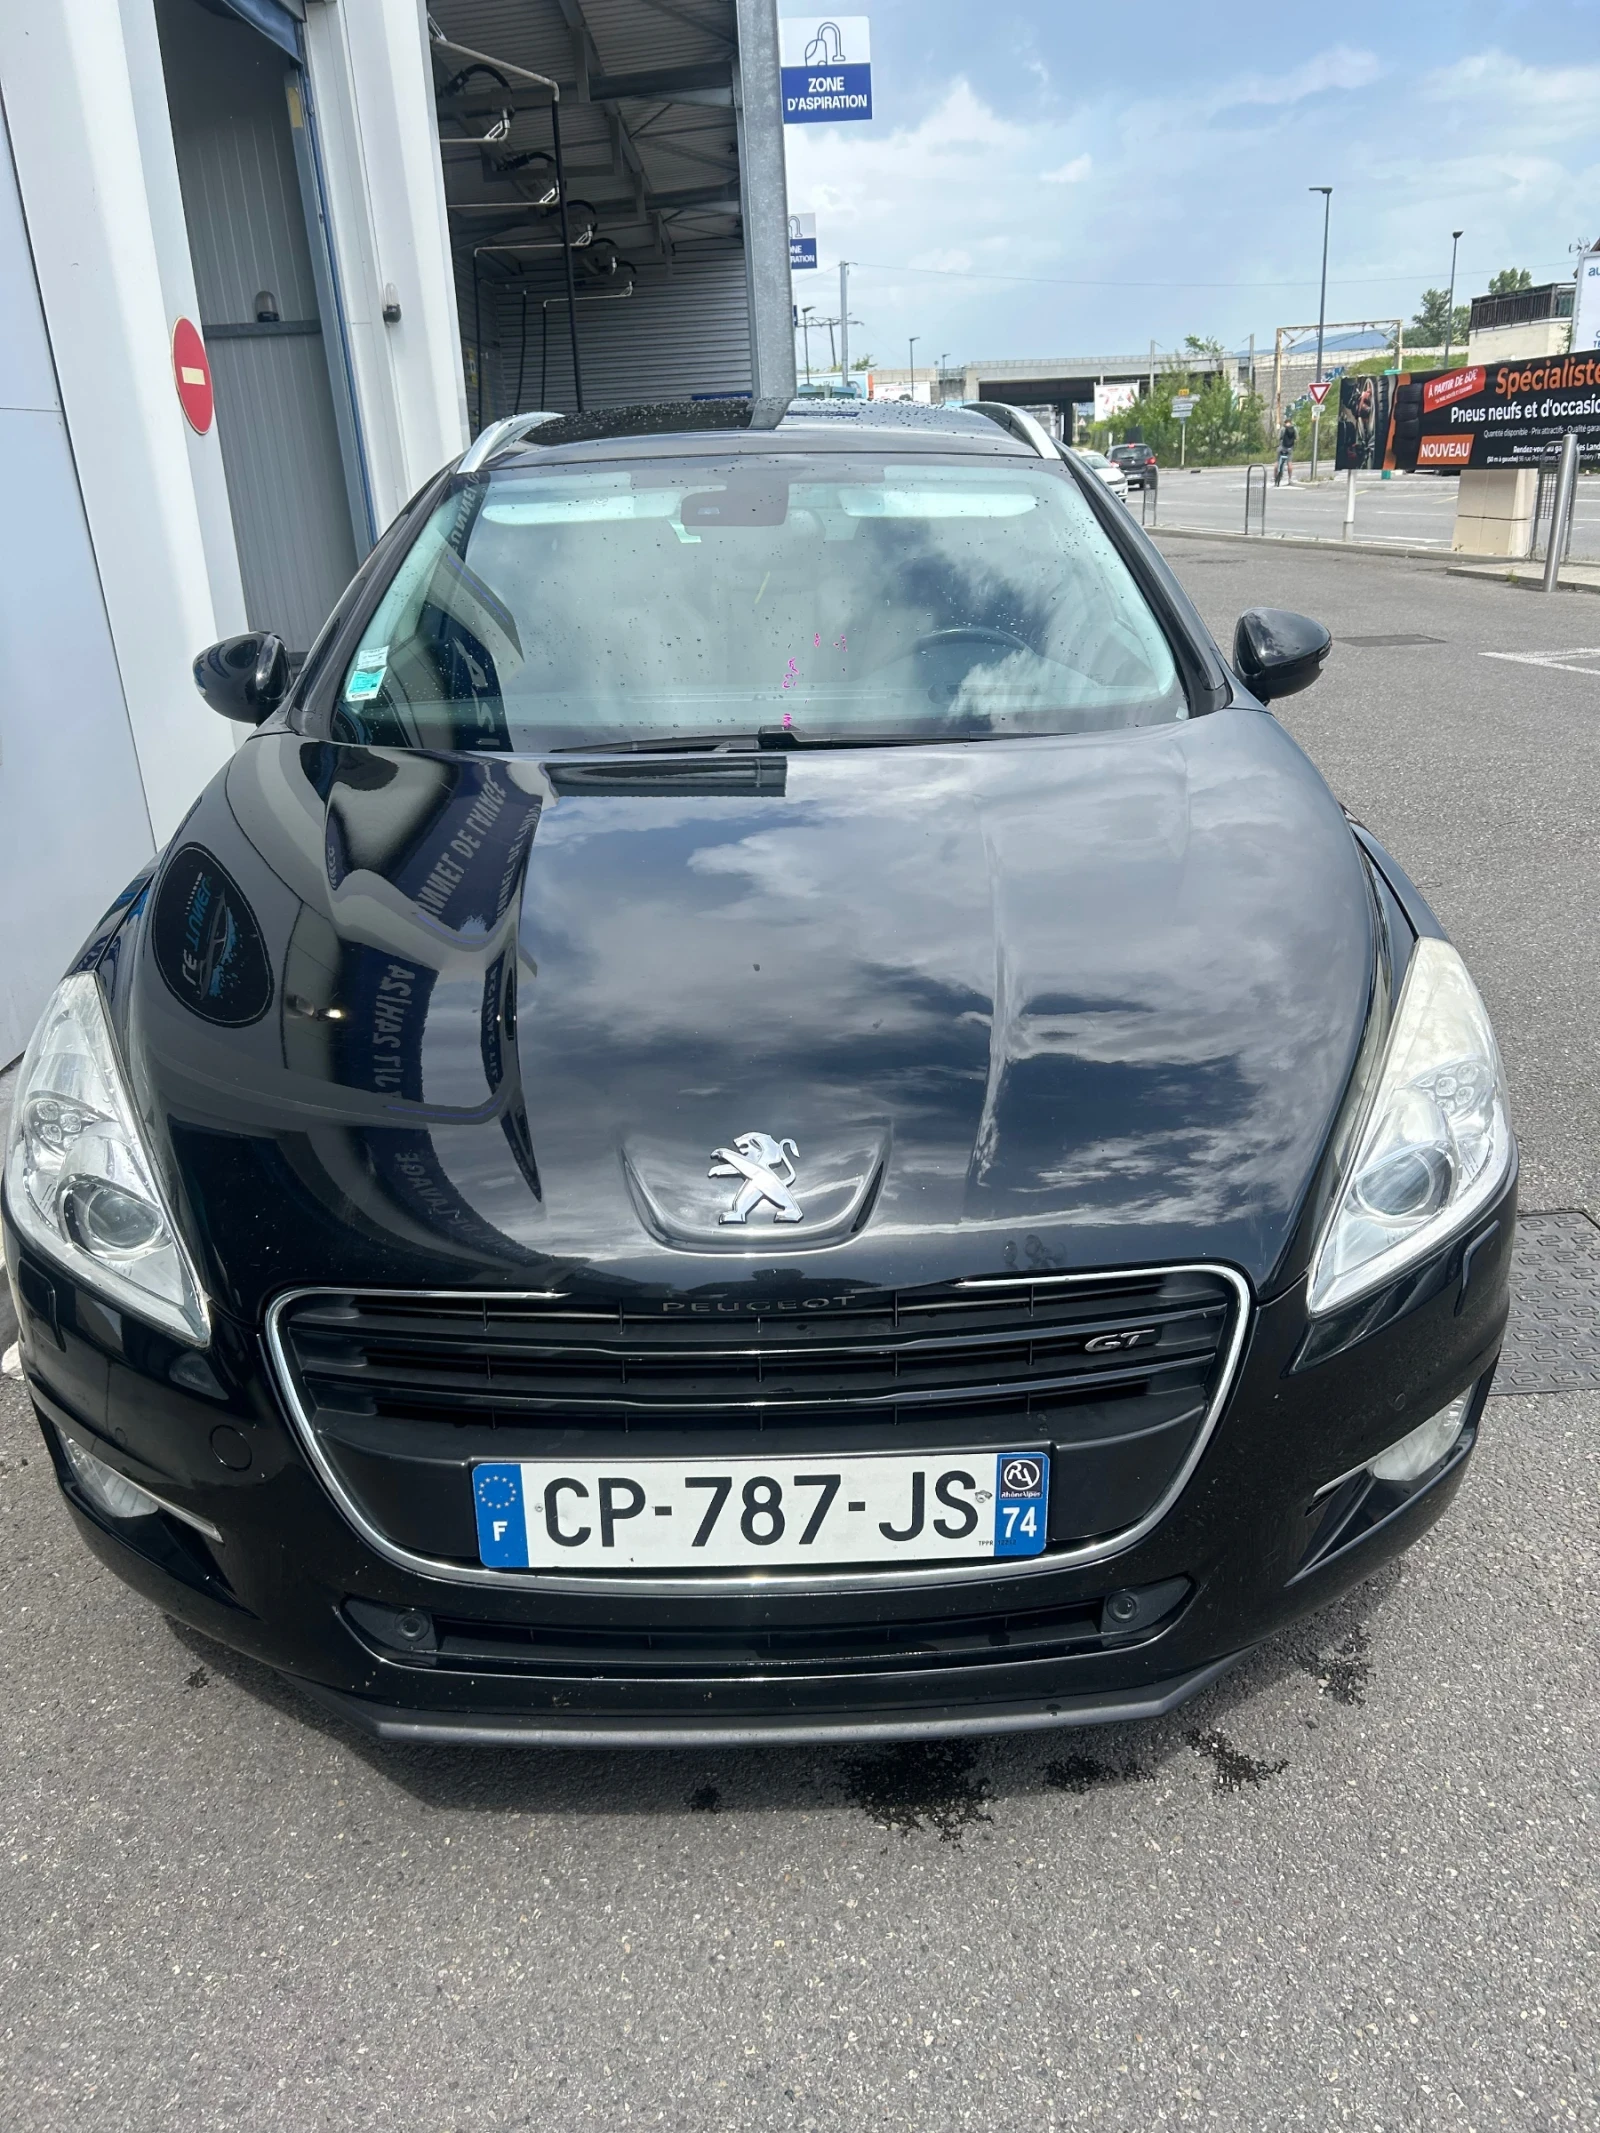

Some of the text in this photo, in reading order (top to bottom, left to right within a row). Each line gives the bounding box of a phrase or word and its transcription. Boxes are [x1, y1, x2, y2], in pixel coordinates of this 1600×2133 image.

[808, 76, 845, 93] ZONE
[787, 94, 868, 111] D'ASPIRATION
[1434, 378, 1455, 396] PARTIR
[1454, 374, 1464, 388] DE
[1451, 406, 1486, 423] Pneus
[1488, 401, 1522, 420] neufs
[1524, 401, 1538, 418] et
[1504, 428, 1528, 438] disponible
[1567, 424, 1587, 434] Qualité
[1420, 442, 1470, 458] NOUVEAU
[662, 1295, 856, 1312] PEUGEOT
[1084, 1328, 1155, 1353] GT
[492, 1469, 979, 1548] F CP-787-JS
[1002, 1506, 1037, 1538] 74
